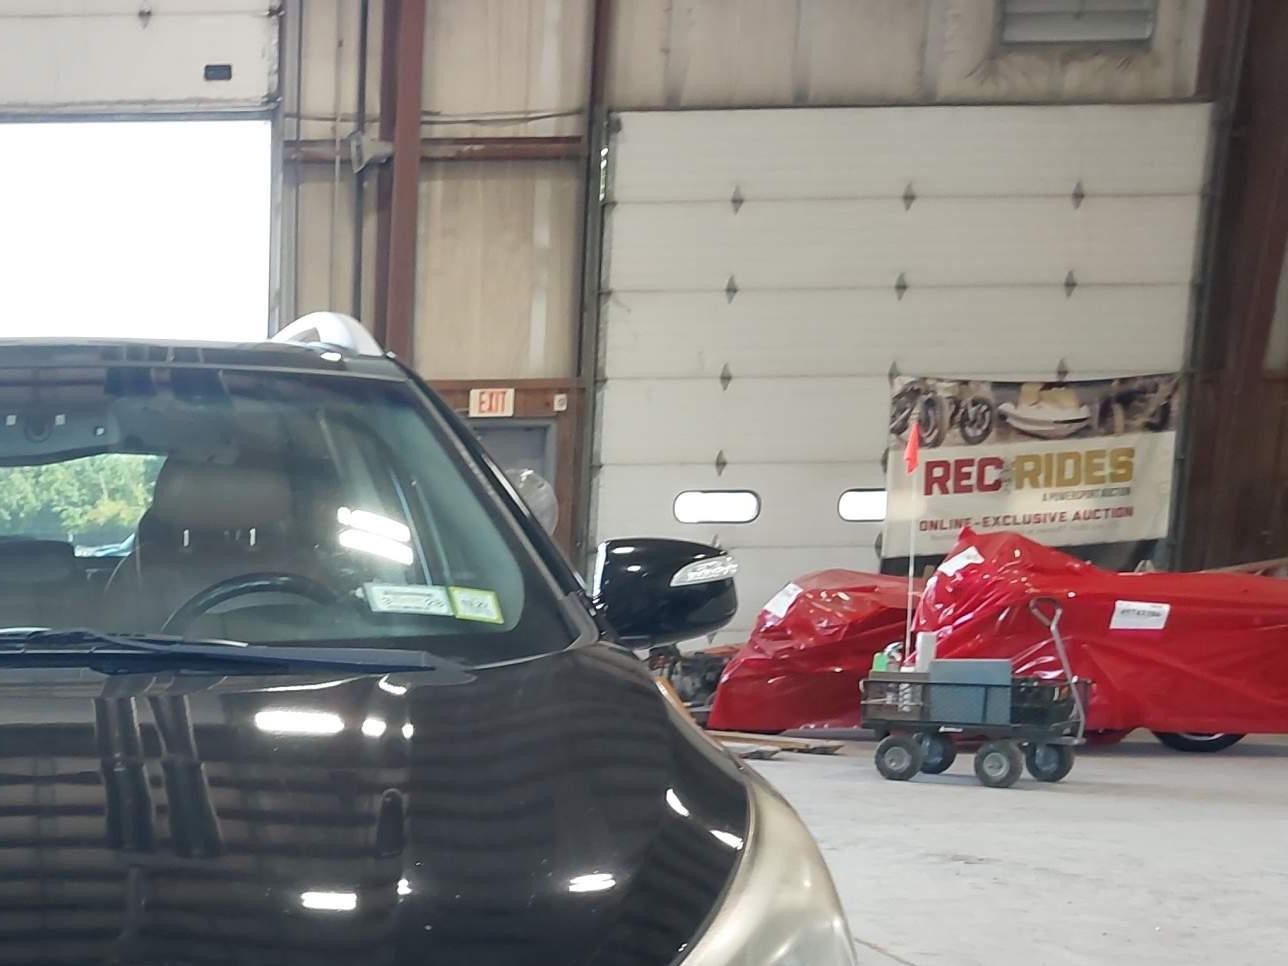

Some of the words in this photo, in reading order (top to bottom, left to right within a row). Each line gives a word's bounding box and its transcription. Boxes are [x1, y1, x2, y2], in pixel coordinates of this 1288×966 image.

[479, 391, 507, 413] EXIT
[924, 457, 1004, 496] REC
[1016, 448, 1135, 489] RIDES
[919, 511, 1067, 531] ONLINE-EXCLUSIVE
[1072, 506, 1135, 522] AUCTION
